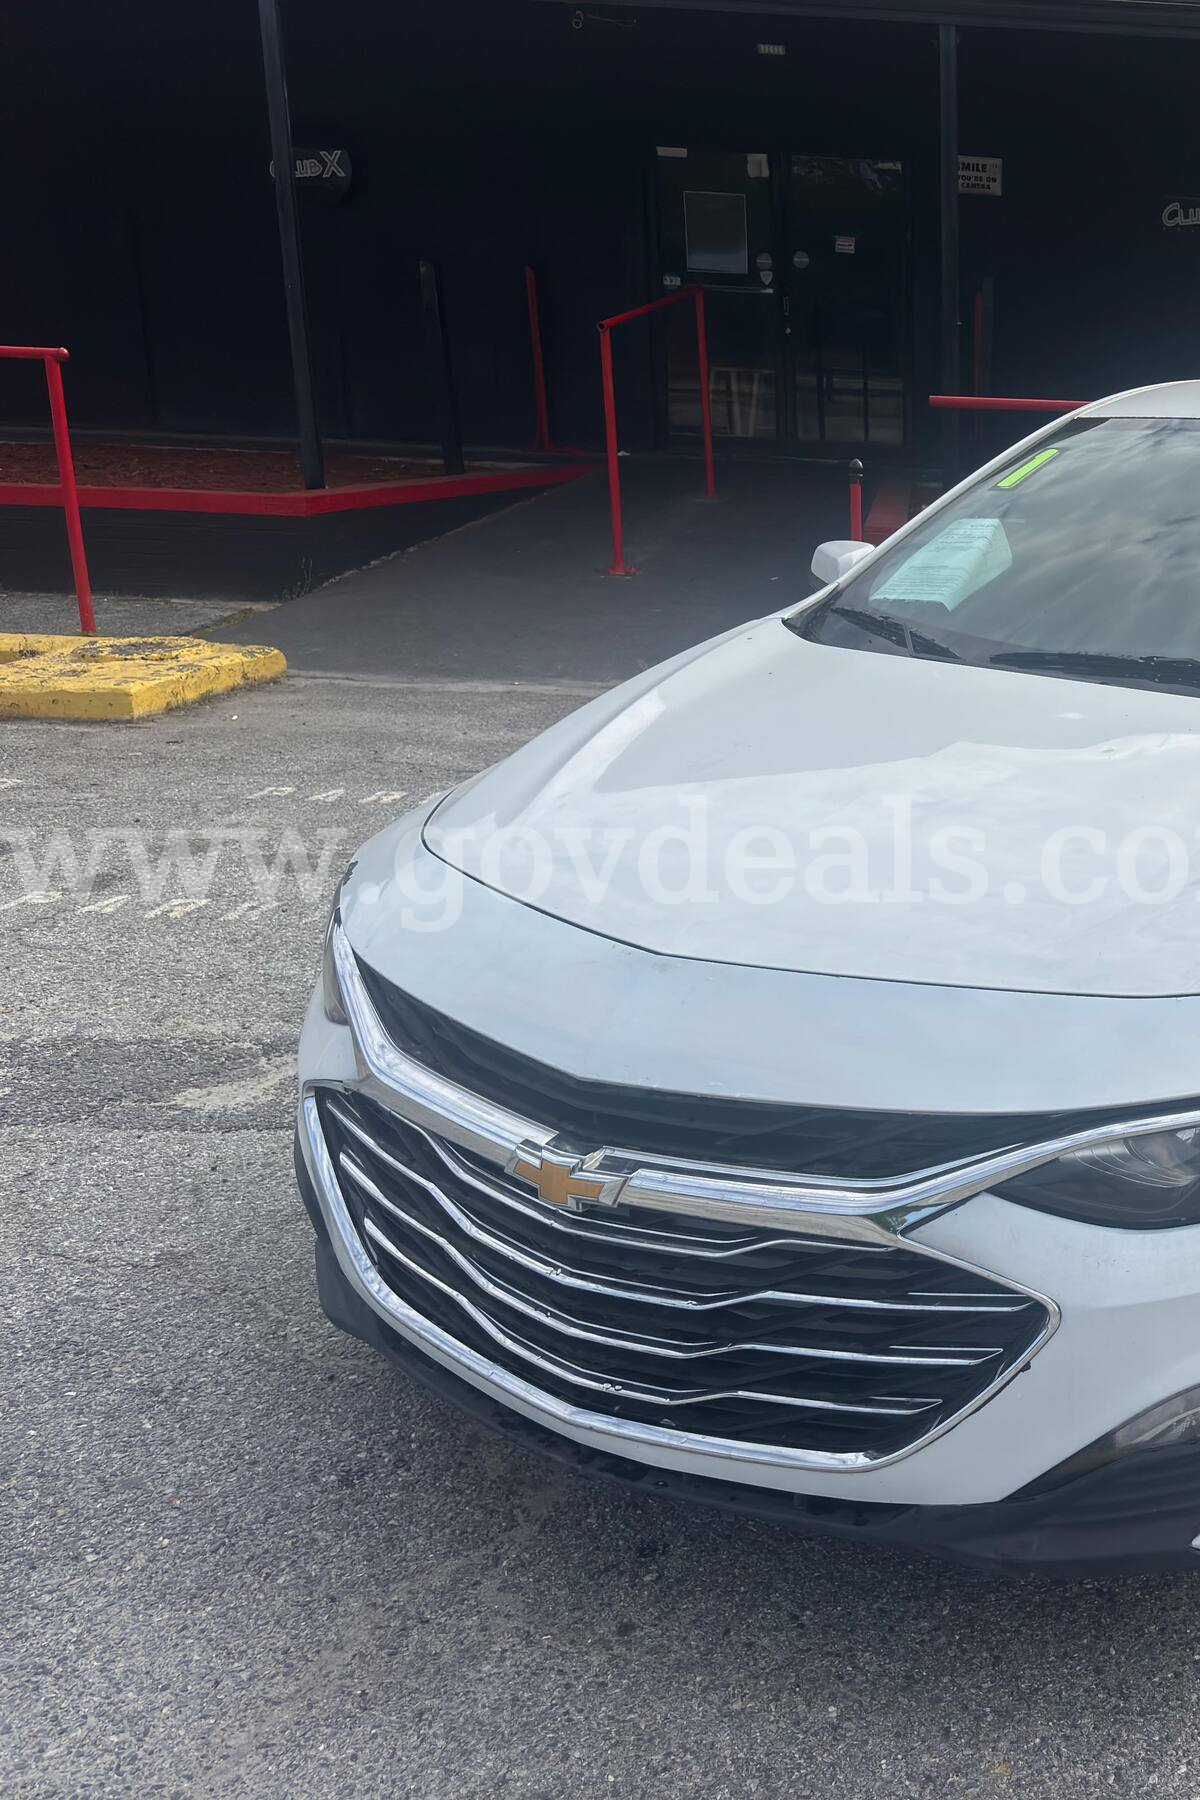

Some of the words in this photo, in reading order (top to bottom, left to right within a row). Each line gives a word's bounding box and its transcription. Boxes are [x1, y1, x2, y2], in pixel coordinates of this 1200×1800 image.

[270, 159, 323, 178] UB
[320, 150, 346, 177] X
[958, 162, 987, 173] MILE
